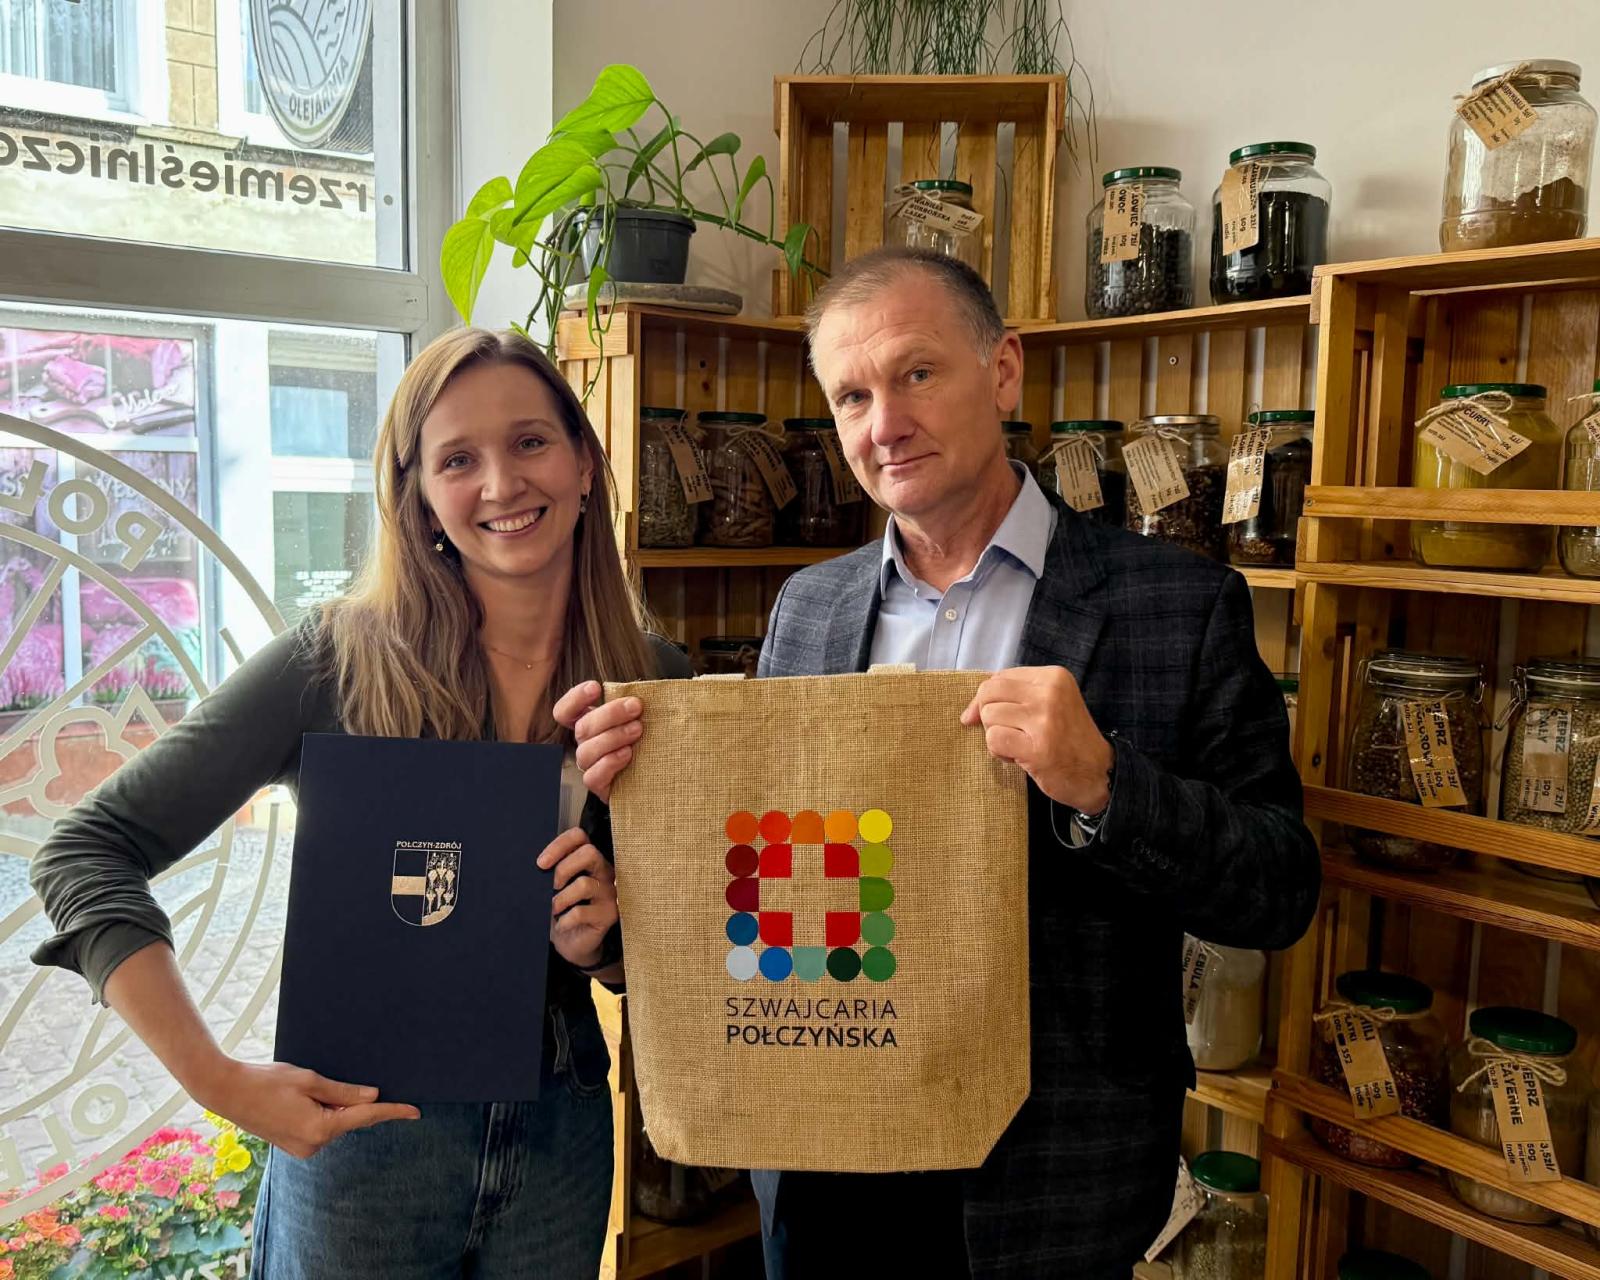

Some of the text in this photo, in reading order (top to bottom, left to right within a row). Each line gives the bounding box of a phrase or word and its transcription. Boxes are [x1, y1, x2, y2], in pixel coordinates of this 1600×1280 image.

[288, 55, 349, 121] OLEJARNIA
[1117, 189, 1126, 214] OWOC
[1463, 406, 1493, 428] CURRY
[1432, 702, 1447, 747] PIEPRZ
[1554, 708, 1568, 753] PIEPRZ
[1541, 779, 1550, 796] 50g
[395, 839, 463, 851] POŁCZYN-ZDRÓJ
[726, 996, 898, 1021] SZWAJCARIA
[726, 1021, 898, 1049] POŁCZYŃSKA
[1521, 1065, 1539, 1107] IEPRZ
[1525, 1142, 1536, 1161] 50g
